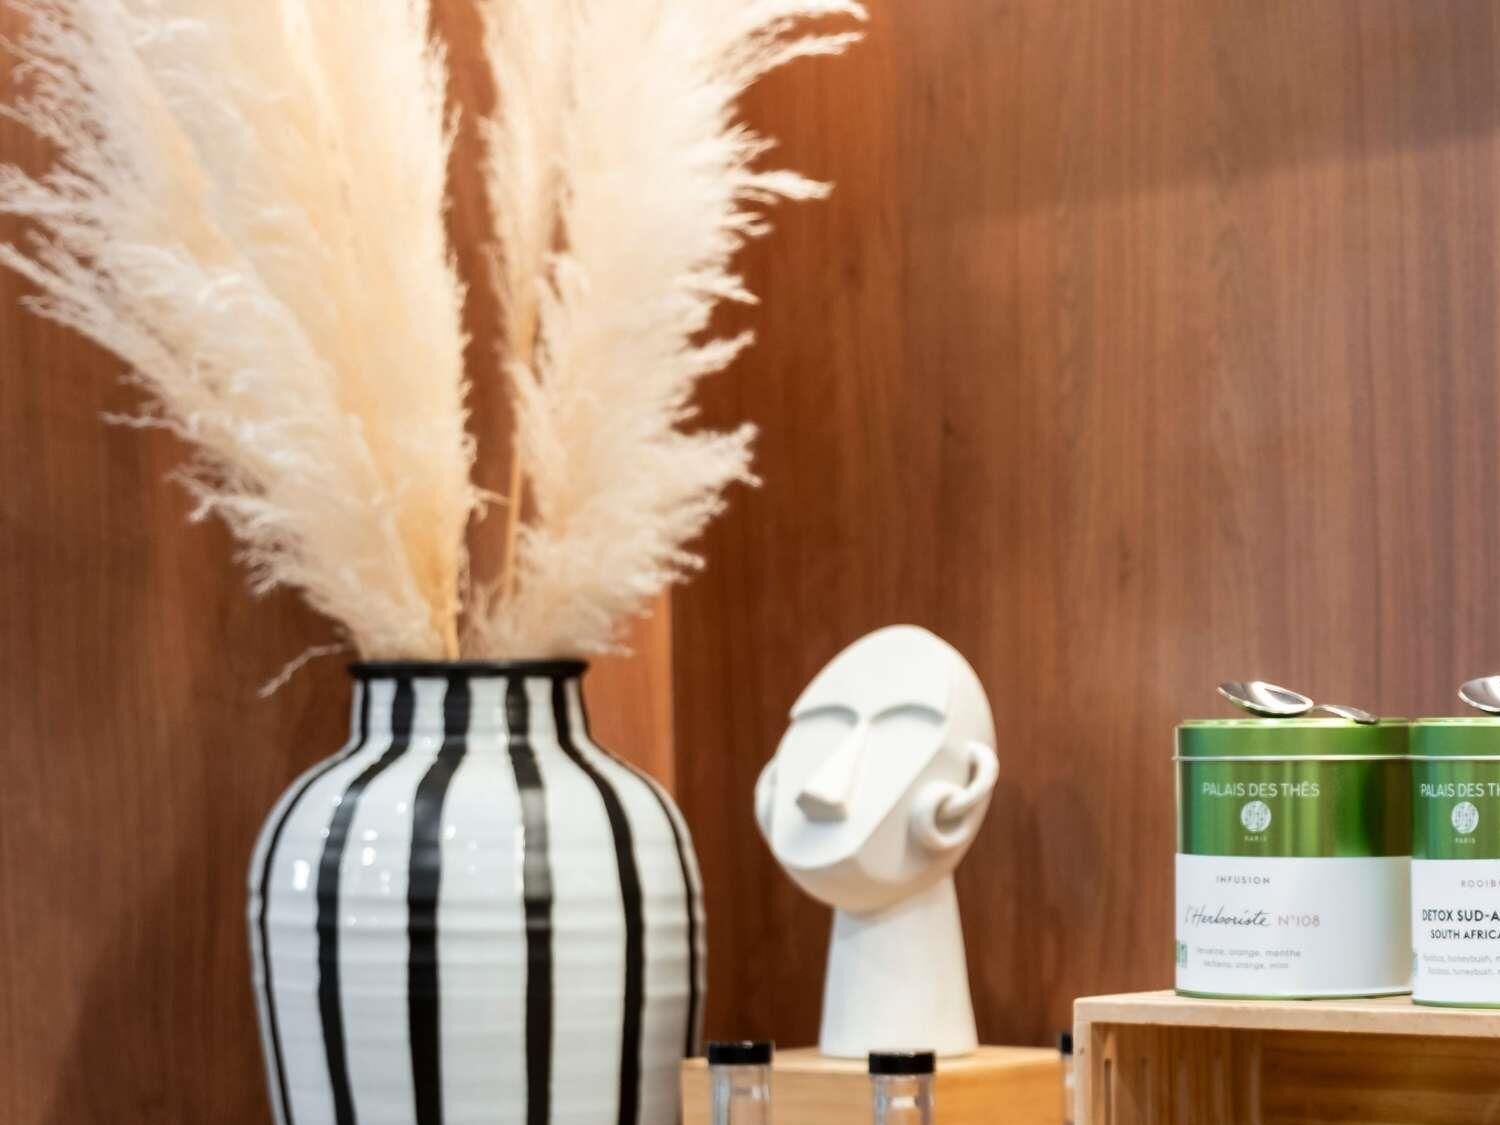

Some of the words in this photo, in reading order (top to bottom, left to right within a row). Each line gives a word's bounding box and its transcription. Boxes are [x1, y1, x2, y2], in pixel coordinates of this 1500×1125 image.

[1202, 782, 1245, 797] PALAIS
[1248, 782, 1278, 797] DES
[1421, 783, 1455, 798] PALAIS
[1458, 783, 1484, 797] DES
[1216, 875, 1271, 885] INFUSION
[1278, 914, 1321, 928] N°108
[1422, 909, 1453, 922] DETOX
[1430, 928, 1460, 940] SOUTH
